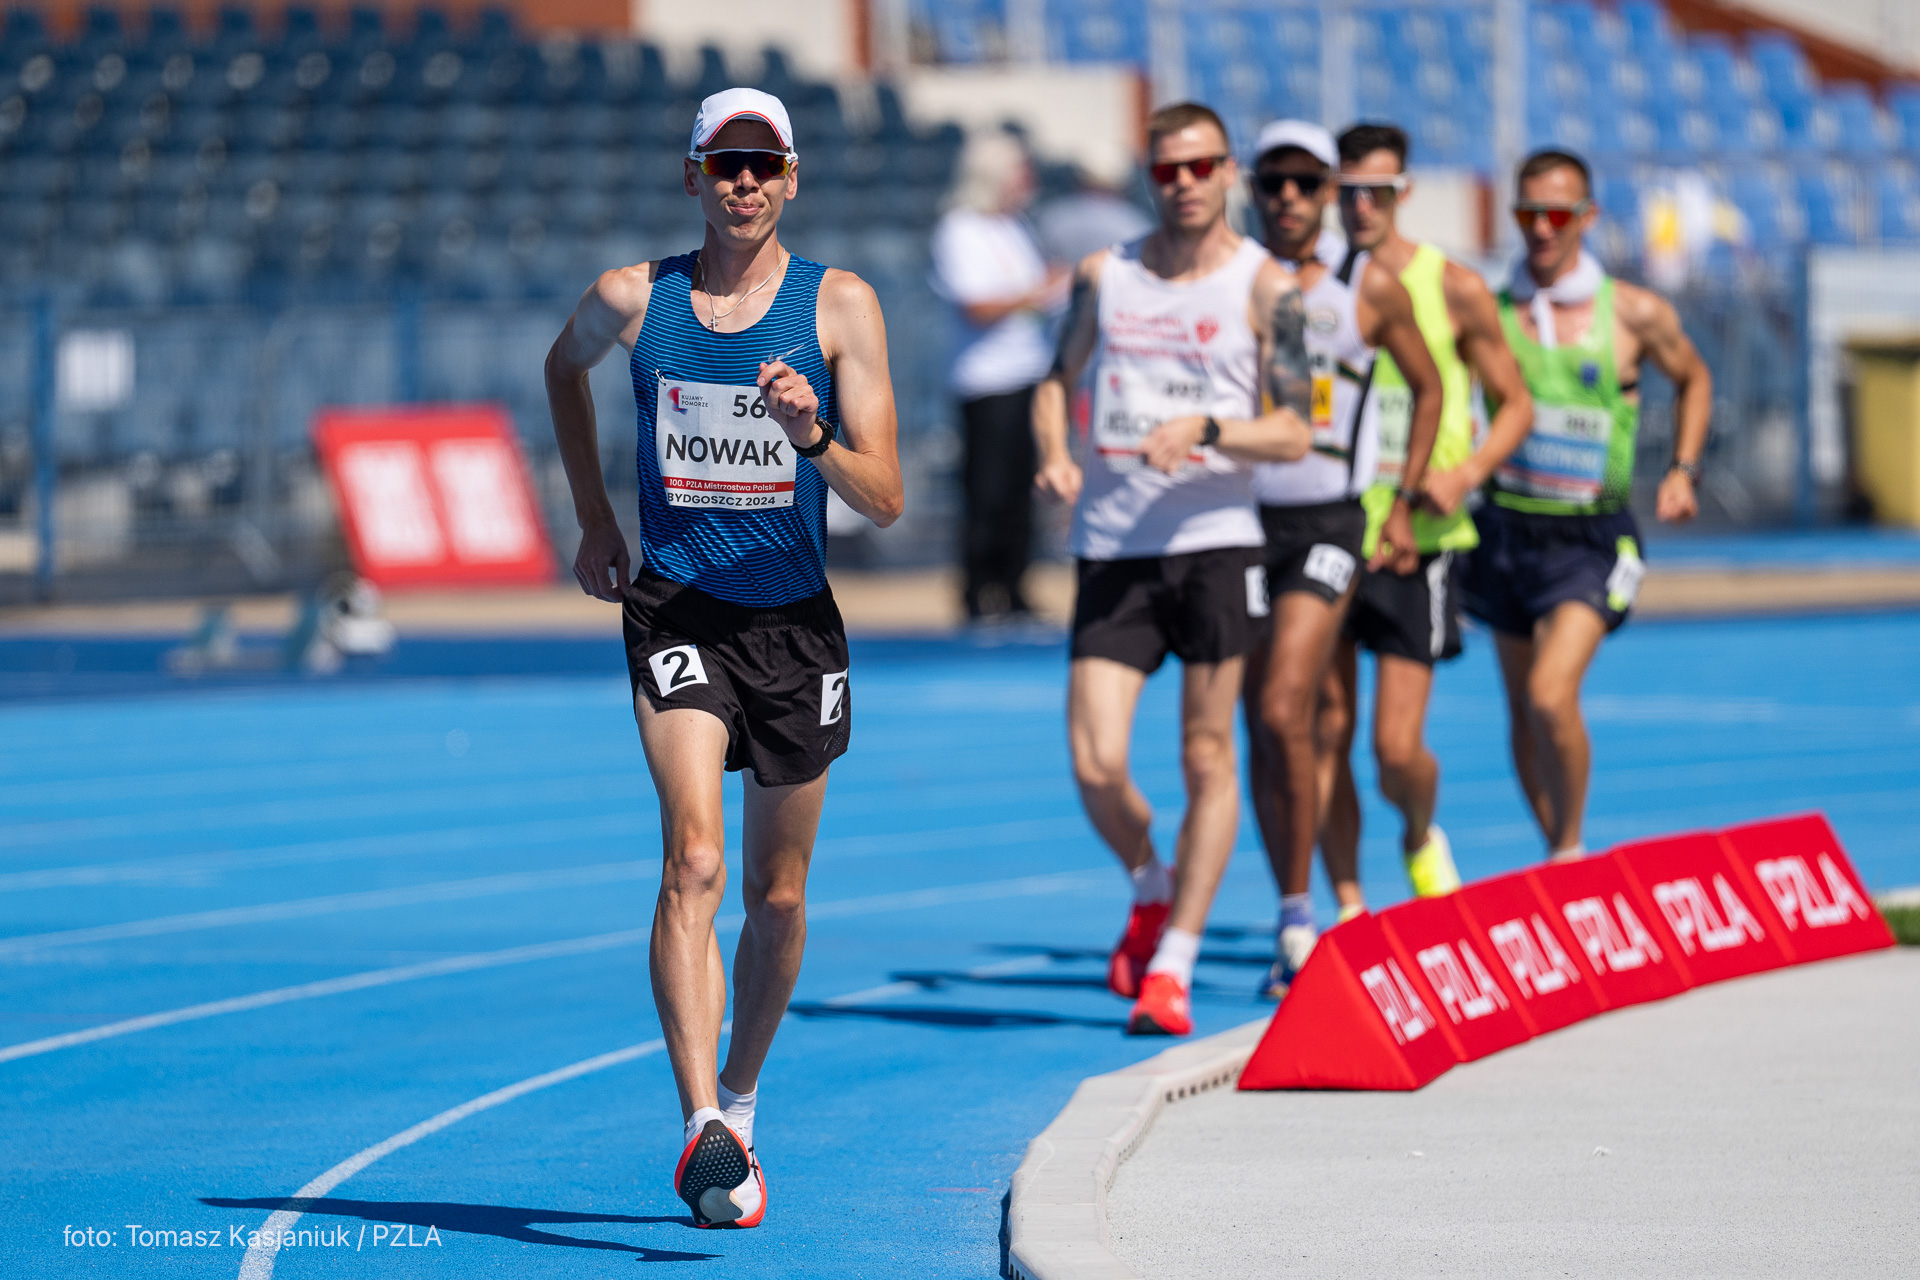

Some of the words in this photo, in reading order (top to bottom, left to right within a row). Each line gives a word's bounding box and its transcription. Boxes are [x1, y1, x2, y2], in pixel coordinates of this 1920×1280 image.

[681, 400, 709, 408] POMORZE
[732, 394, 772, 419] 56
[665, 433, 783, 467] NOWAK
[667, 492, 743, 507] BYDGOSZCZ
[745, 496, 776, 507] 2024
[669, 478, 685, 488] 100.
[686, 480, 703, 490] PZLA
[704, 482, 751, 492] Mistrzostwa
[752, 483, 776, 492] Polski
[662, 651, 697, 688] 2
[1652, 871, 1765, 957] PZLA
[1754, 851, 1870, 932] PZLA
[1488, 912, 1581, 999] PZLA
[1562, 891, 1664, 976] PZLA
[1360, 956, 1436, 1046] PZLA
[1416, 938, 1510, 1025] PZLA
